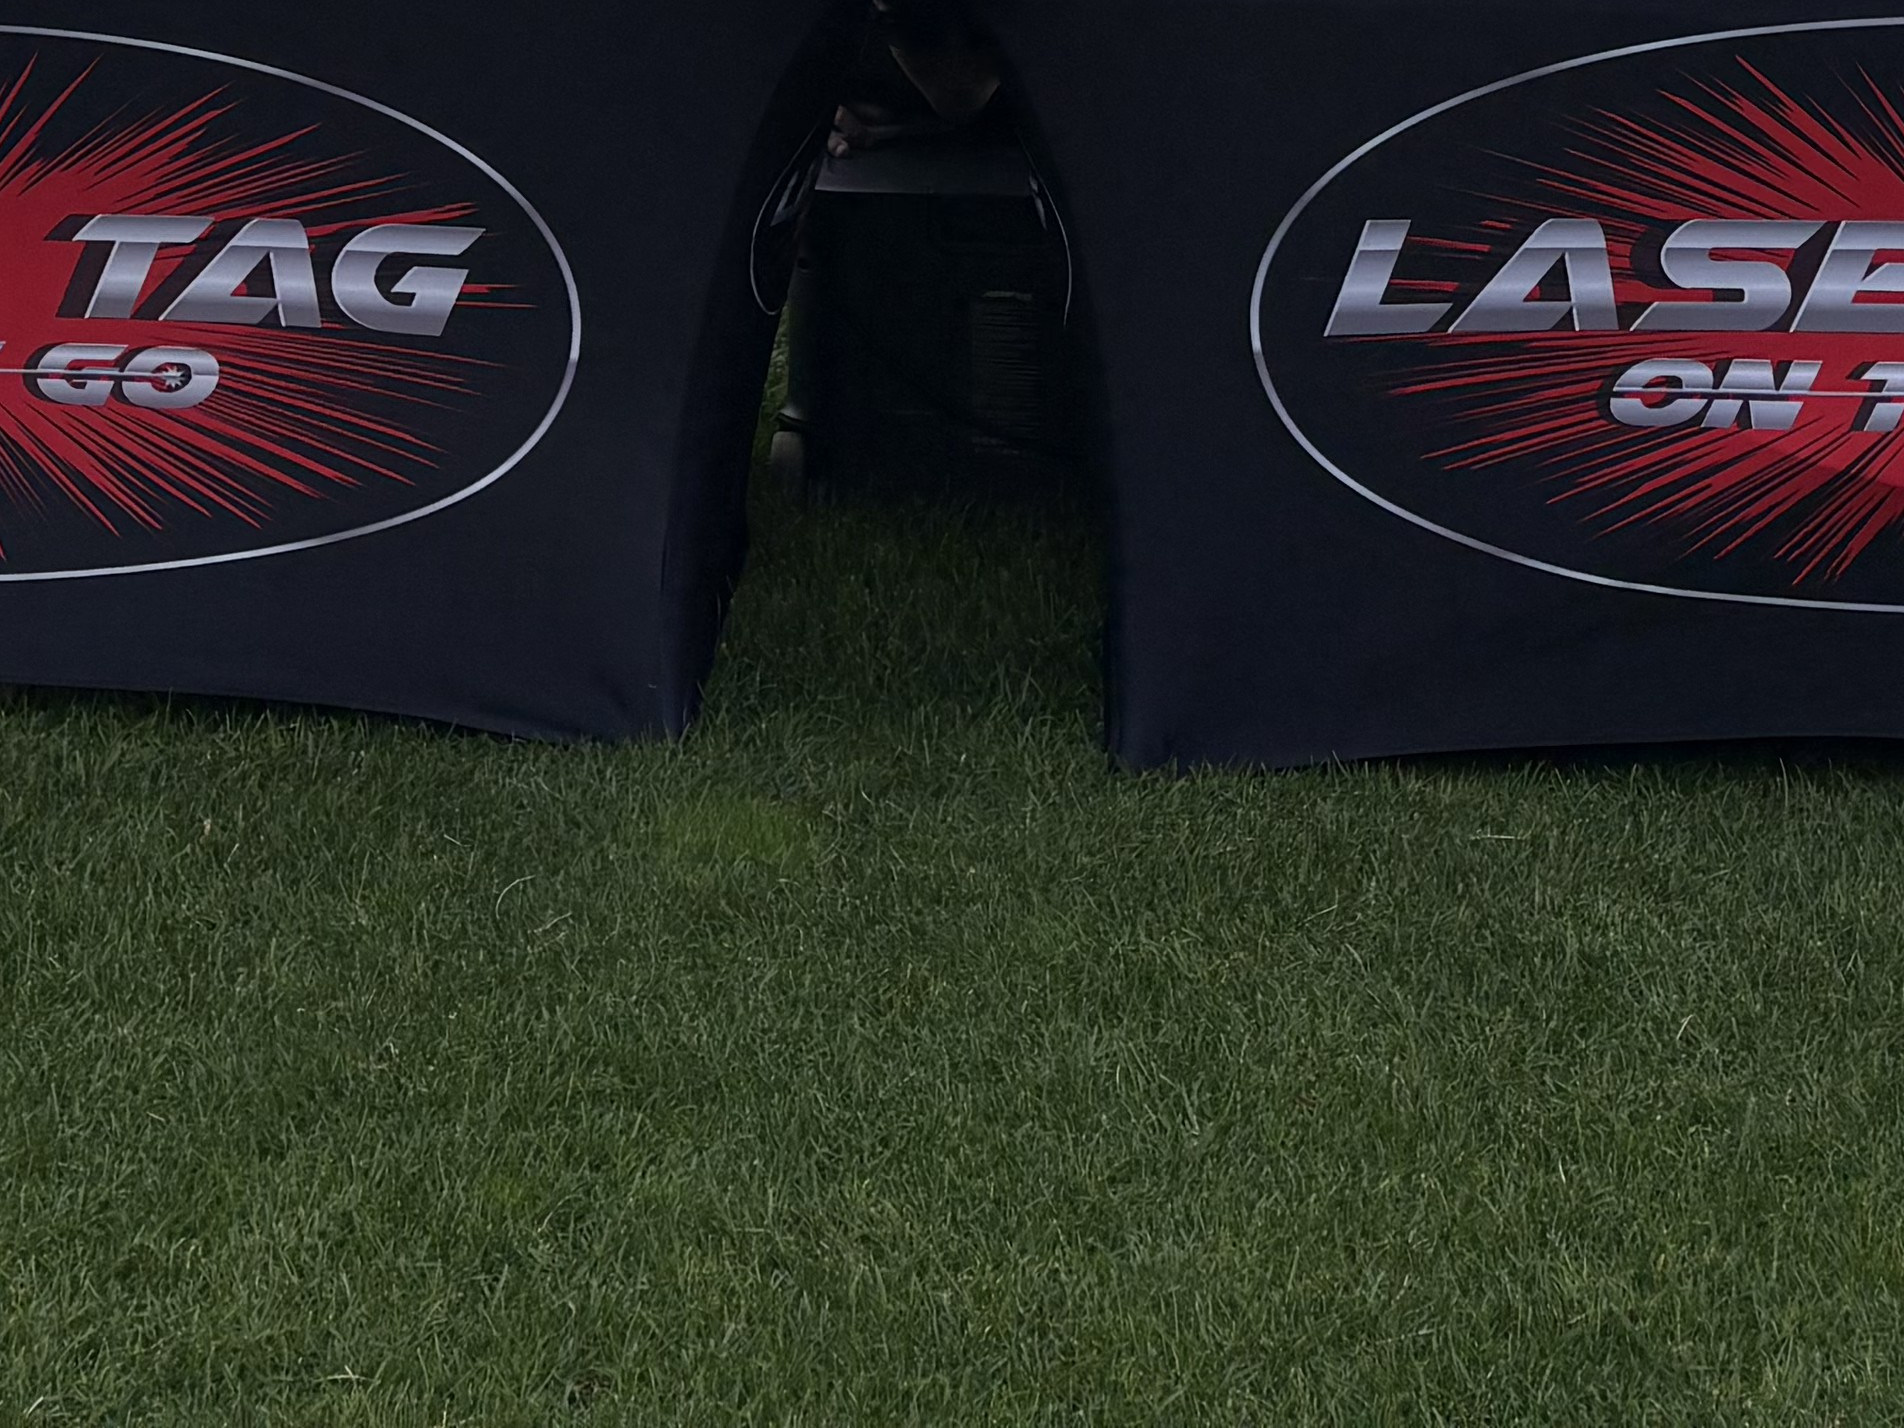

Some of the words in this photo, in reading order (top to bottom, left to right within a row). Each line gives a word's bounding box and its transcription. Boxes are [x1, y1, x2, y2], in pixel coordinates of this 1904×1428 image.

[61, 212, 486, 336] TAG
[36, 344, 220, 410] GO
[1607, 356, 1825, 432] ON
